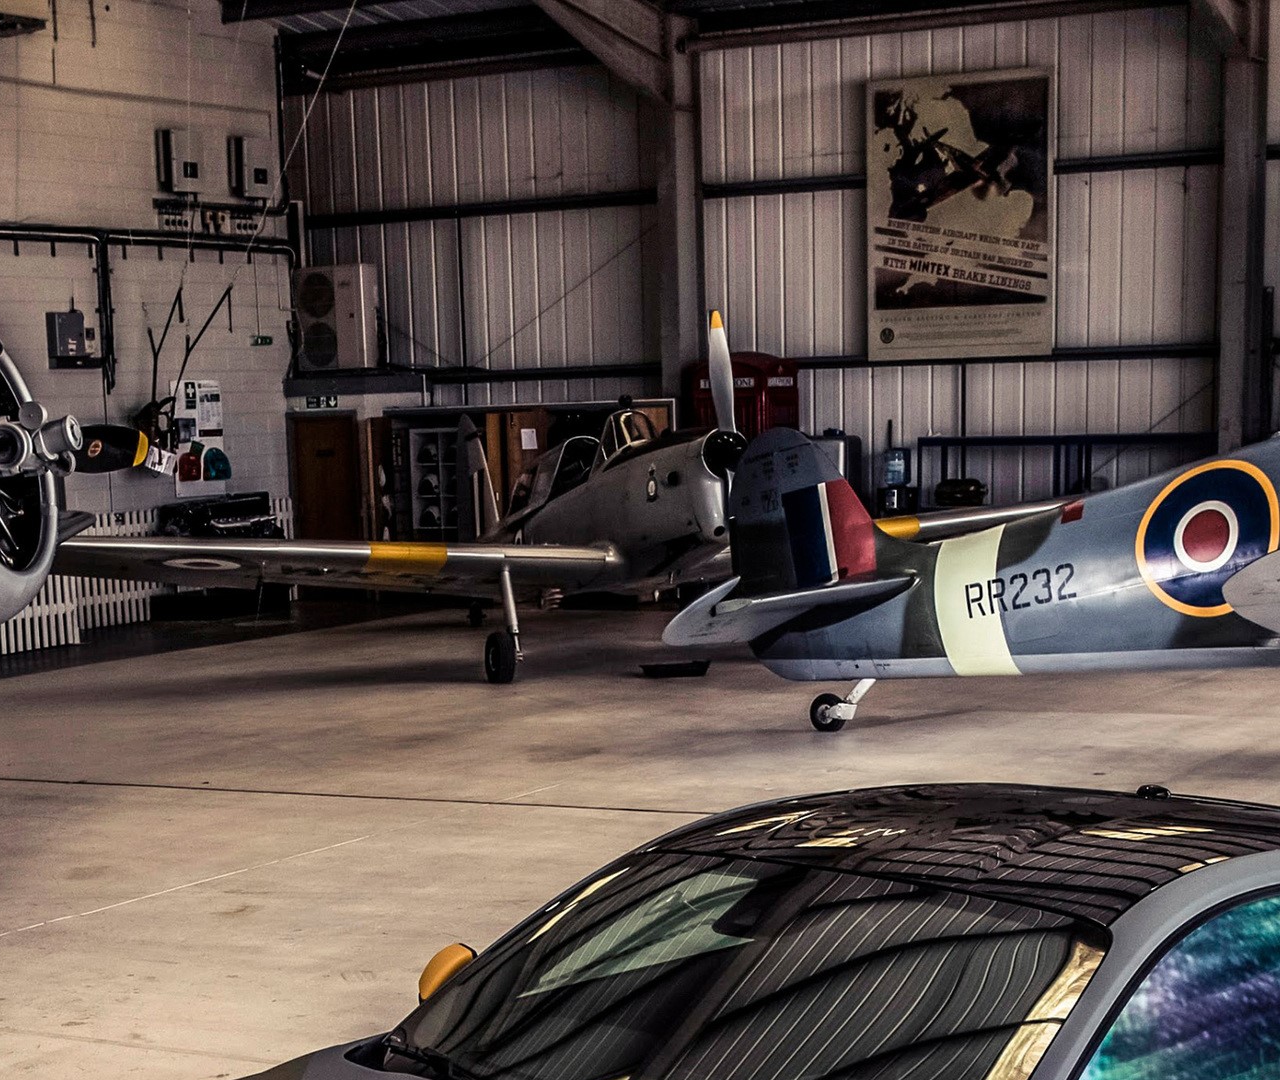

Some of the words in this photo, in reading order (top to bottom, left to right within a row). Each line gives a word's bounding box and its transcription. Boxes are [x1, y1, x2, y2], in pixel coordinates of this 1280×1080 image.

[942, 228, 977, 239] AIRCRAFT
[979, 234, 1000, 245] WHICH
[1002, 238, 1019, 248] TOOK
[1020, 241, 1040, 251] PART
[883, 256, 907, 269] WITH
[909, 259, 951, 277] MINTEX
[952, 268, 986, 282] BRAKE
[988, 274, 1032, 291] LININGS
[965, 563, 1077, 619] RR232
